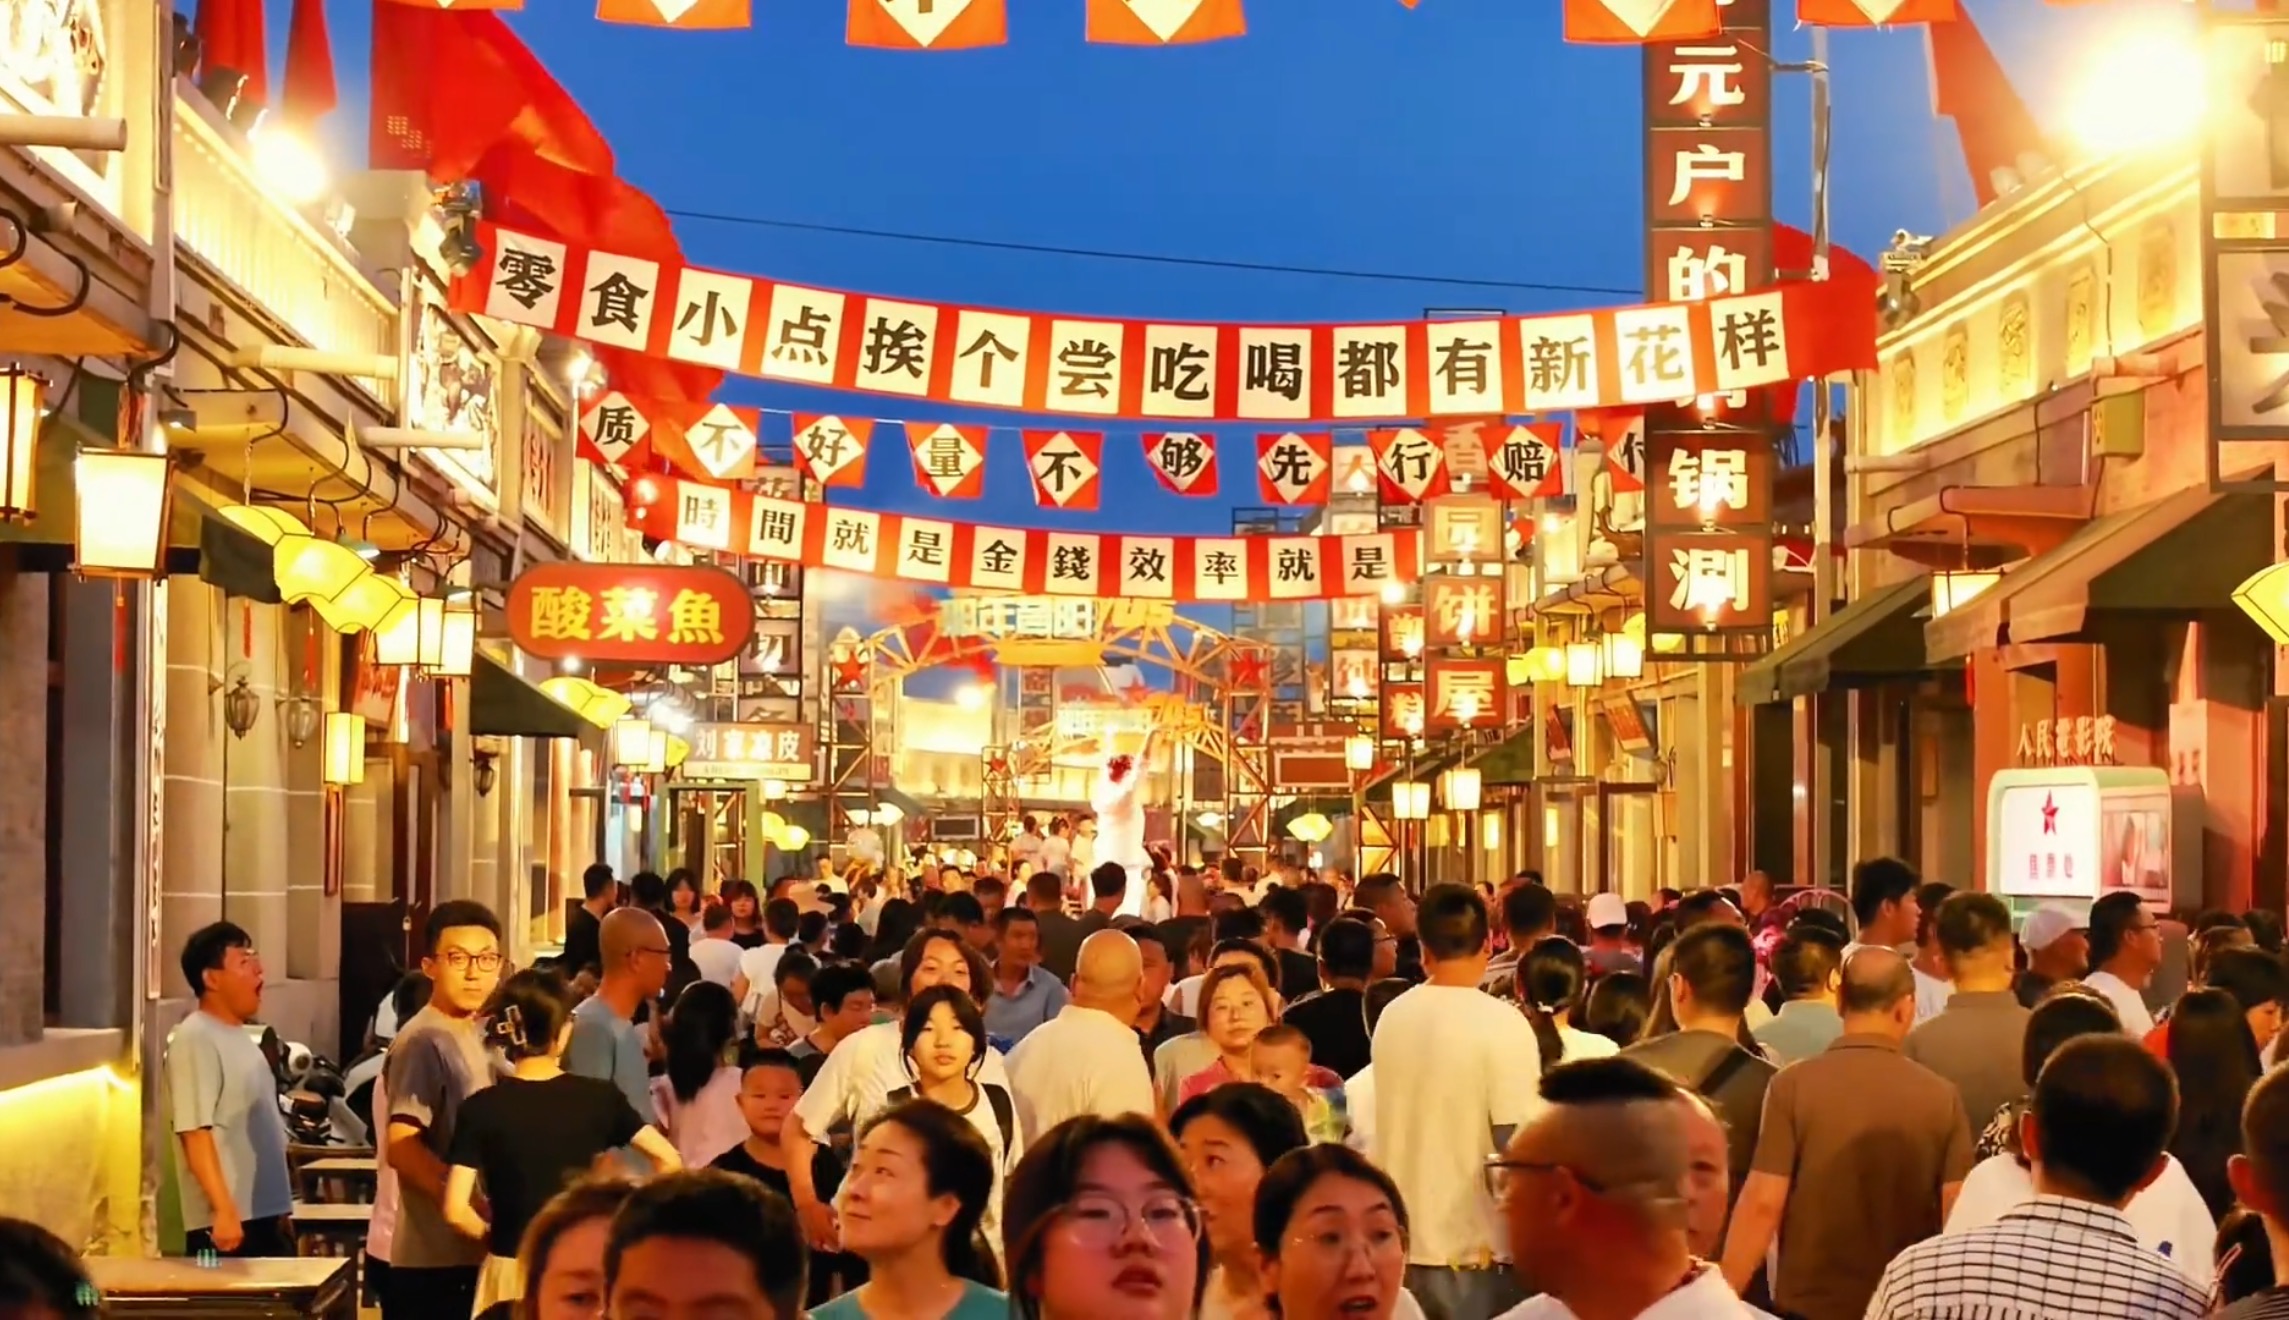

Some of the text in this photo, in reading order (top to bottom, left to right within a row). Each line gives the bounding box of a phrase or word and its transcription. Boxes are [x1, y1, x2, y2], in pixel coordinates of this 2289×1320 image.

[497, 246, 1782, 401] 零食小点挨个尝吃喝都有新花样
[684, 495, 1388, 585] 時間就是金錢效率就是
[530, 586, 725, 644] 酸菜魚
